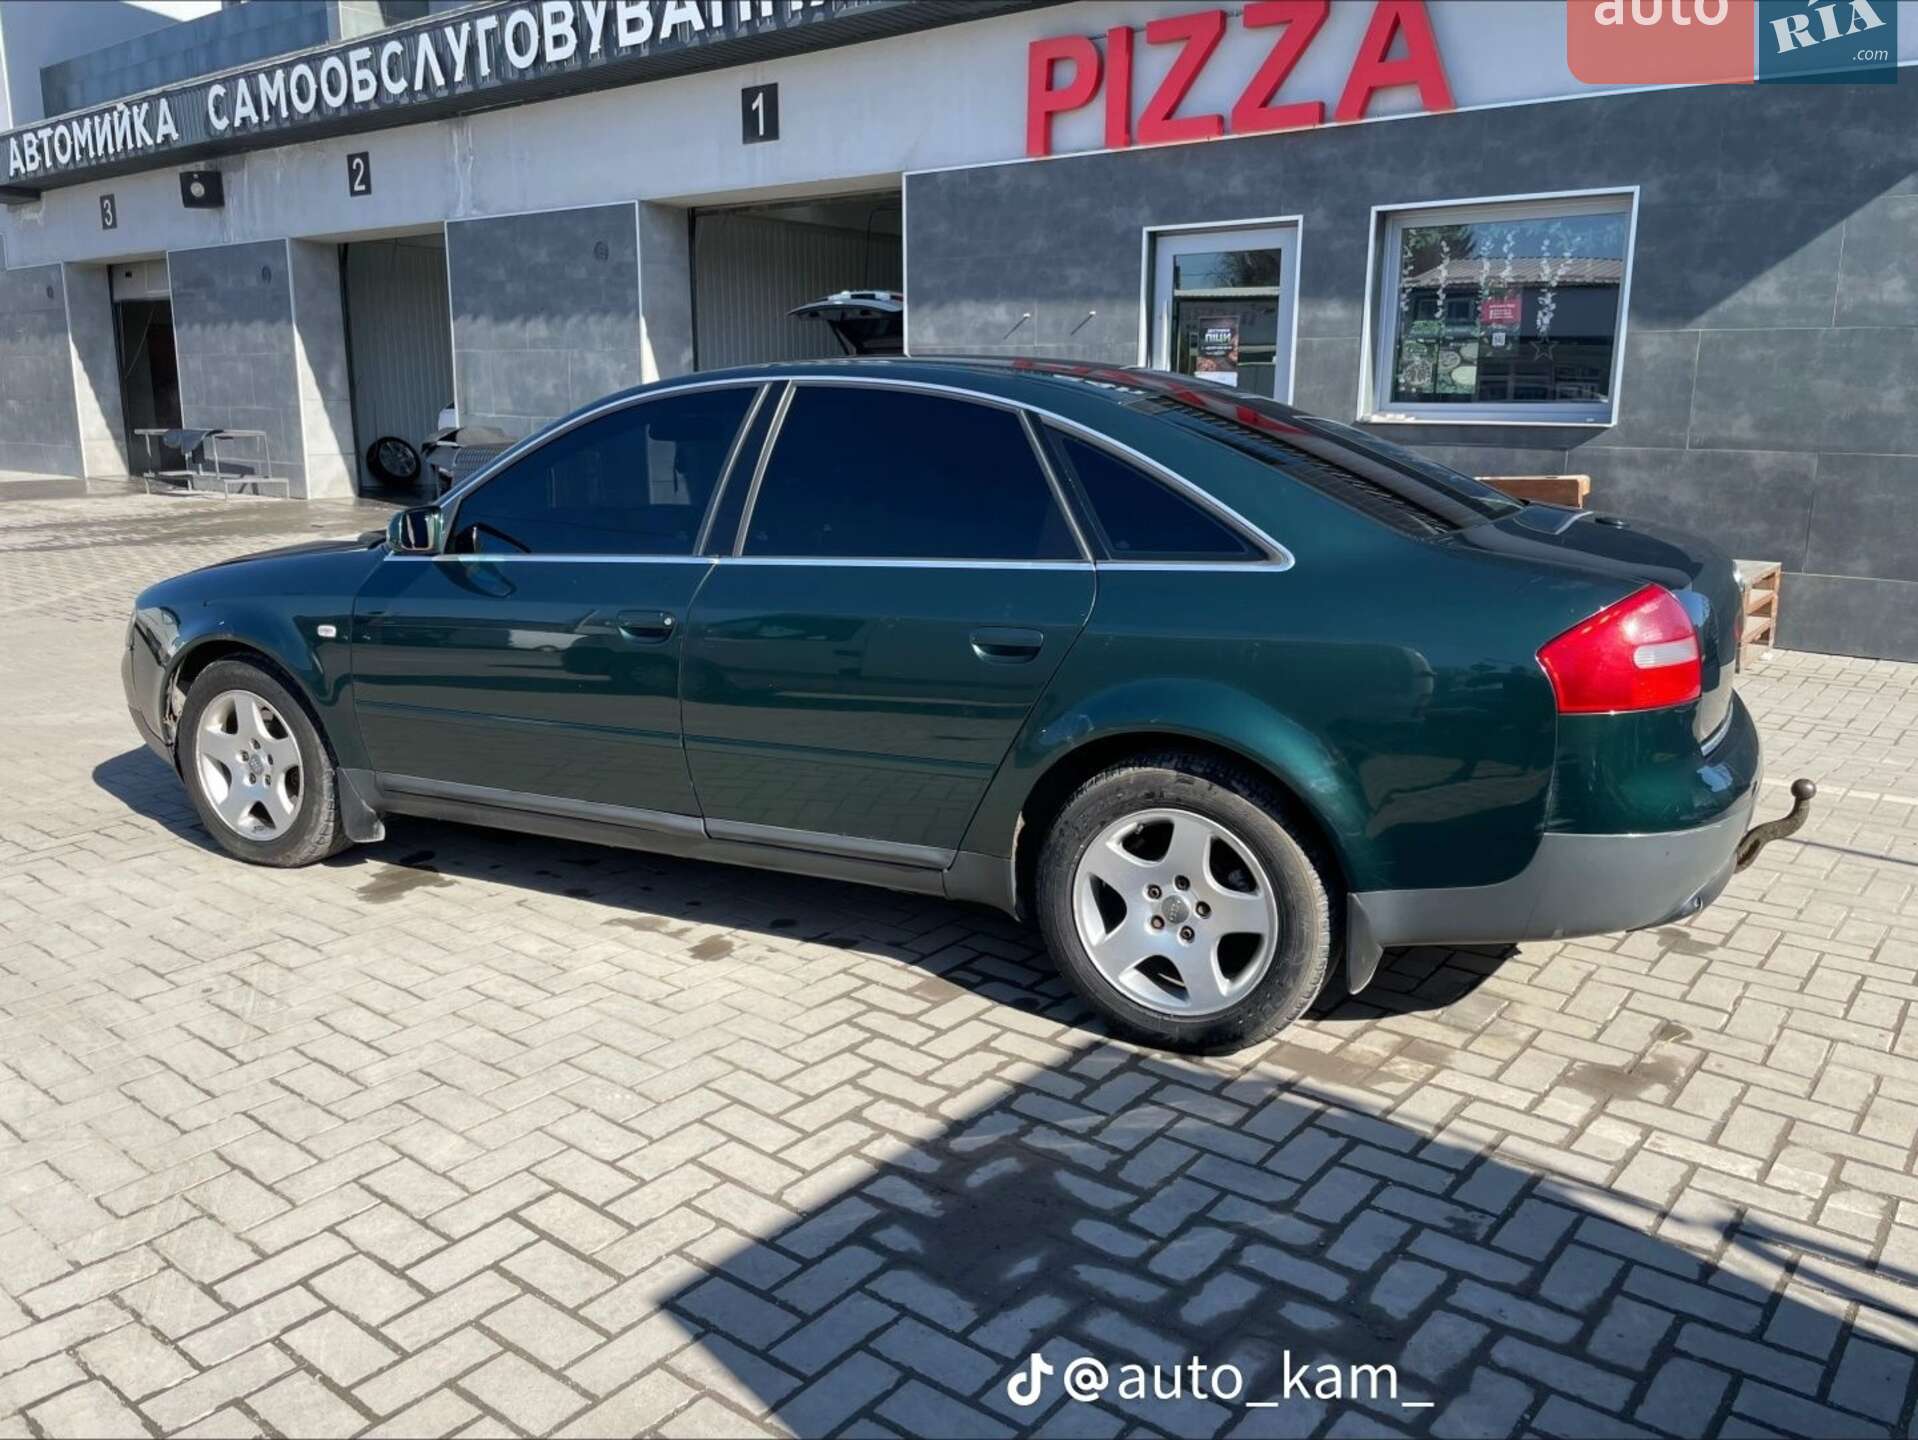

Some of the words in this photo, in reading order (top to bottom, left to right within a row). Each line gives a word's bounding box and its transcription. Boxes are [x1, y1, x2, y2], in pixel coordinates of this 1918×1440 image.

[8, 98, 180, 177] АВТОМИЙКА
[207, 0, 824, 131] САМООБСЛУГОВУВА
[1027, 0, 1455, 157] PIZZA
[752, 92, 764, 136] 1
[353, 157, 365, 191] 2
[103, 199, 113, 226] 3
